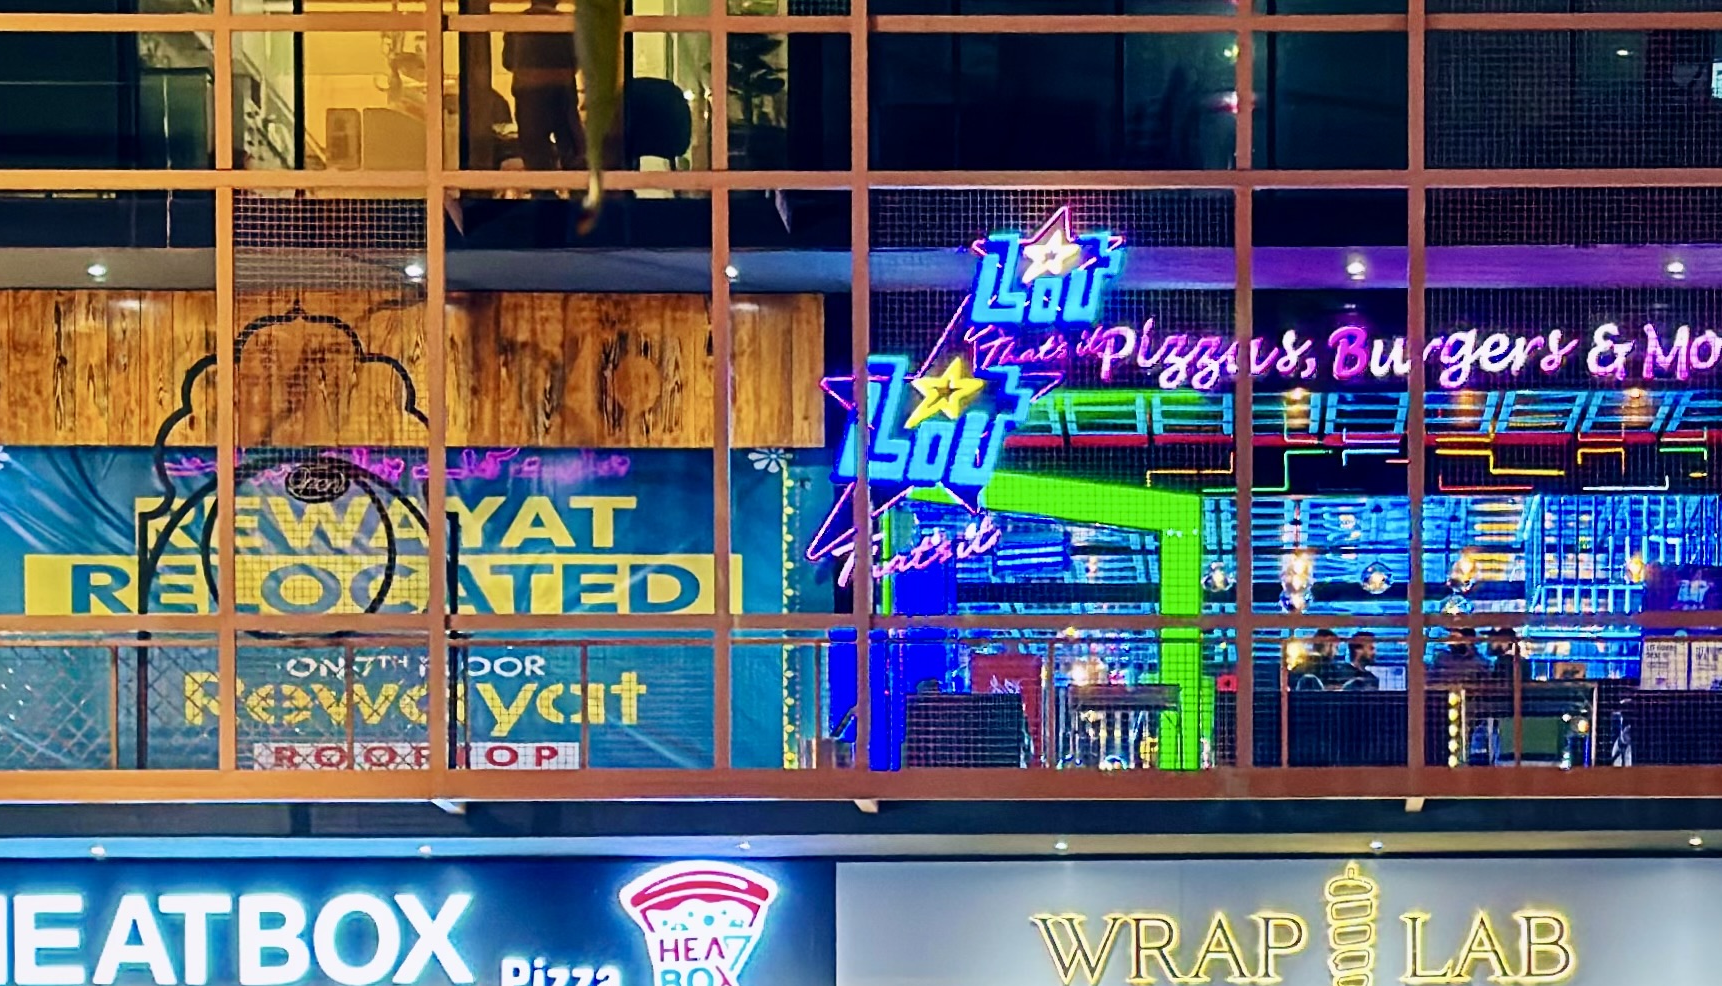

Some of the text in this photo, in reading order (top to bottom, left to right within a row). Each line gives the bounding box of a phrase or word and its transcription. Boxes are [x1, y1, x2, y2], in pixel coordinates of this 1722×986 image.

[1329, 325, 1578, 388] Burgers
[1587, 322, 1634, 380] &
[1397, 908, 1577, 986] LAB
